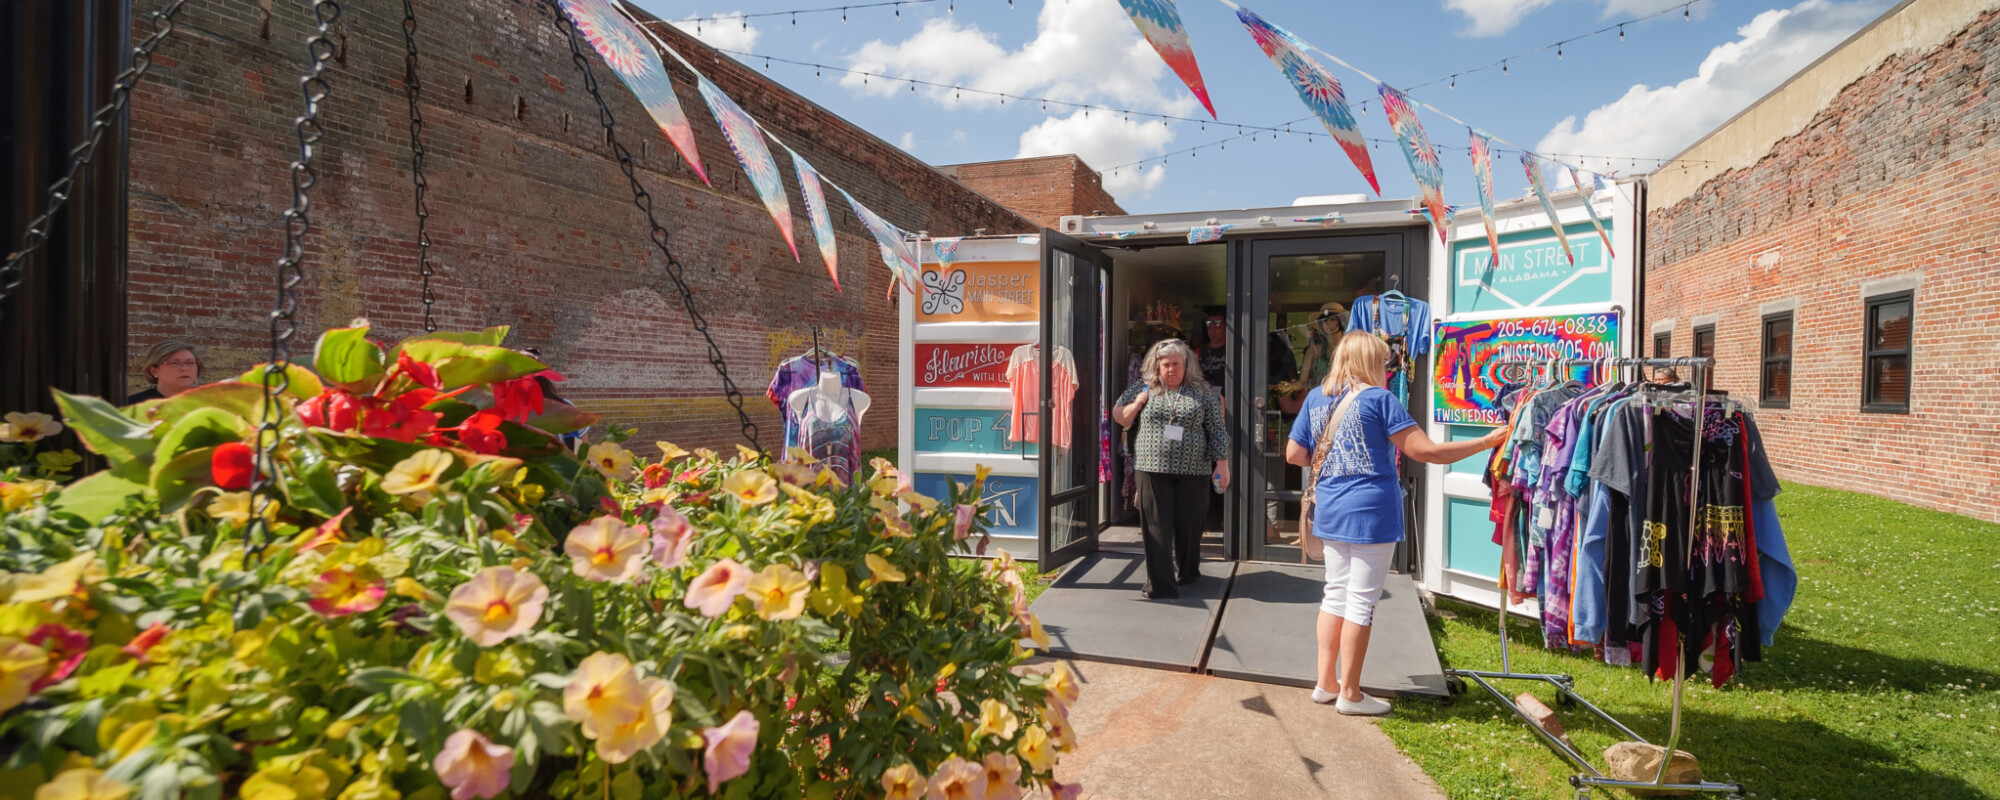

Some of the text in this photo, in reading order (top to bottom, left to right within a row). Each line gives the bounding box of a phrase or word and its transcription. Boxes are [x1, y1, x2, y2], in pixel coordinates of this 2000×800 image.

[1474, 253, 1515, 276] MAIN
[1499, 269, 1559, 283] ALABAMA
[968, 272, 1031, 290] Jasper
[967, 289, 1032, 304] MAIN STREET
[1497, 315, 1608, 338] 205-674-0838
[1435, 342, 1492, 366] TWISTED
[1497, 339, 1615, 363] TWISTEDTS205.COM
[924, 344, 1005, 384] Flourish
[973, 372, 995, 383] WITH
[928, 416, 982, 442] POP
